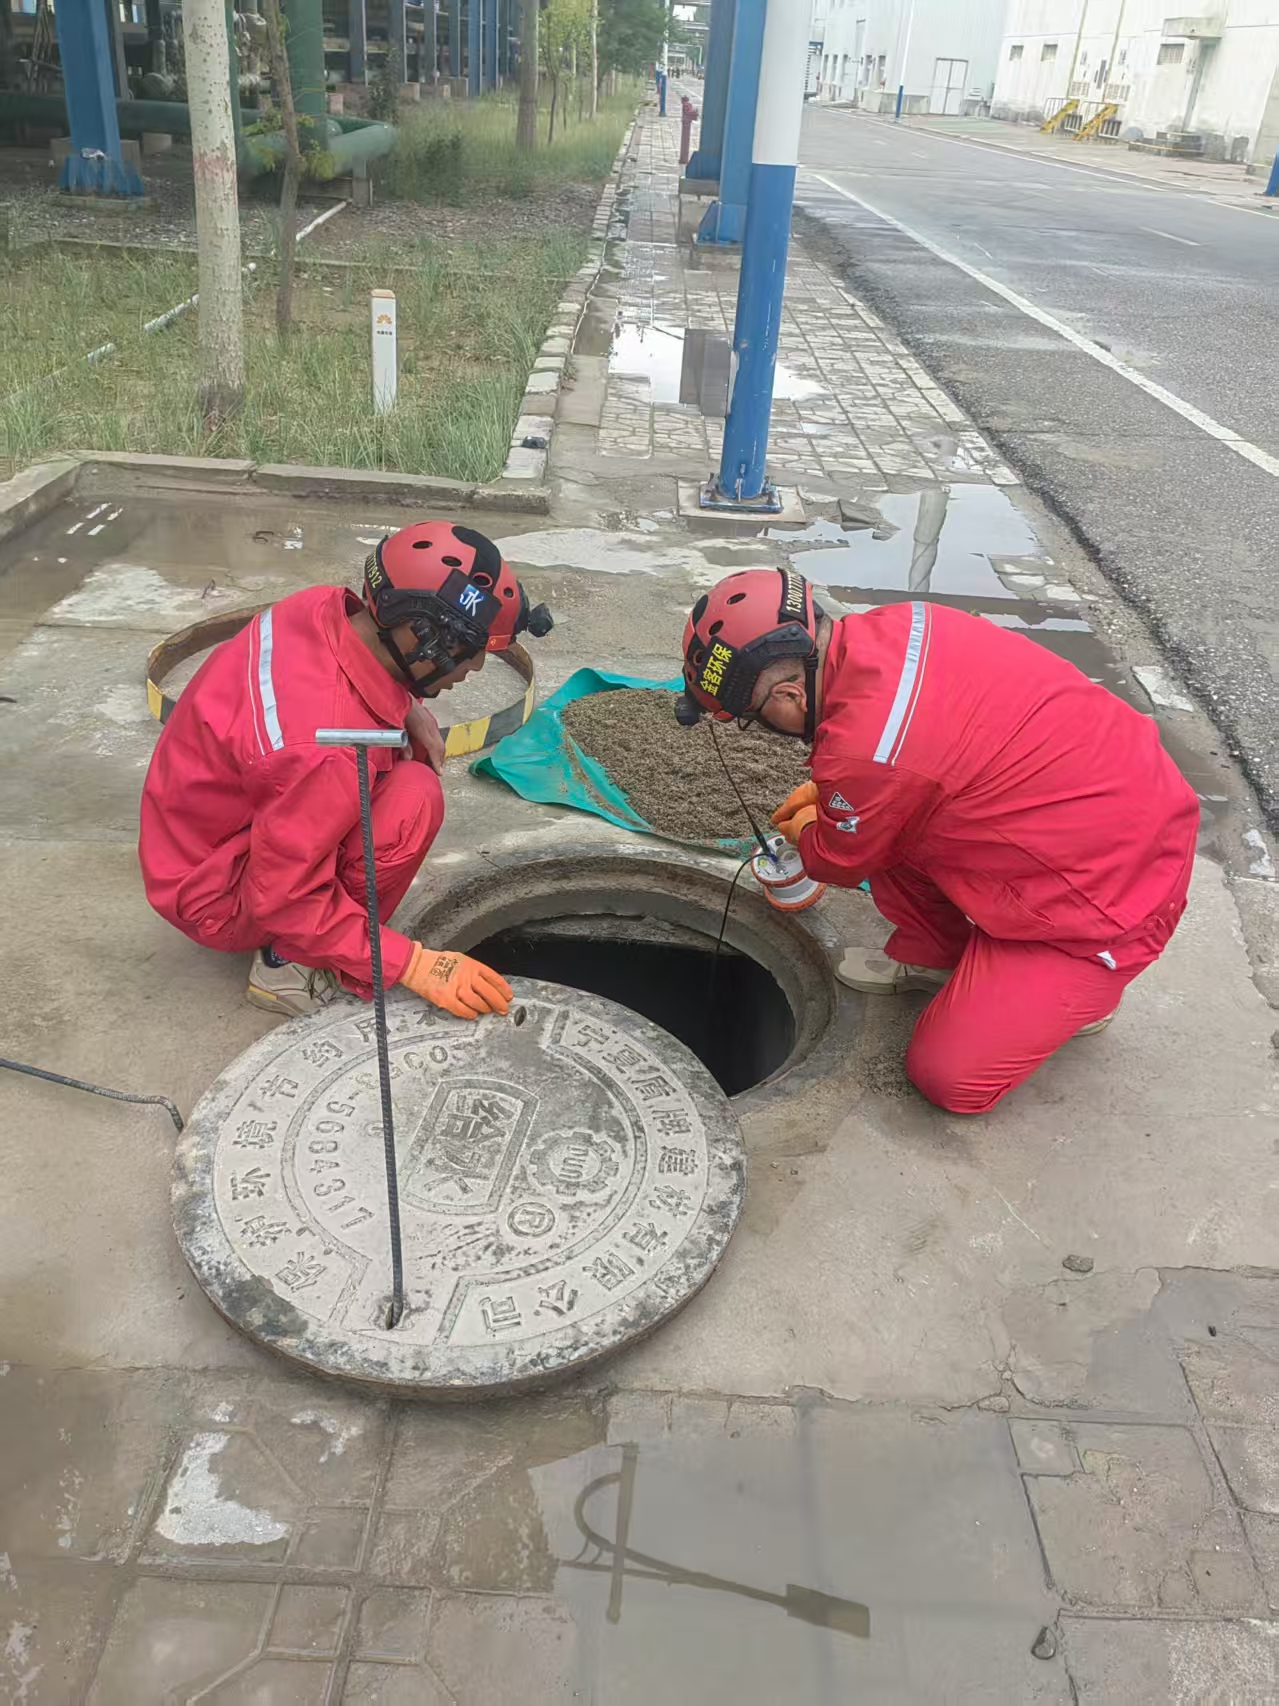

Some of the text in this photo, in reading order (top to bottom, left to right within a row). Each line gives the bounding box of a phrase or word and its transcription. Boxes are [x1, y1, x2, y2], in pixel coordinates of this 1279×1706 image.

[460, 588, 484, 617] JK
[699, 643, 733, 697] 金客环保
[424, 1093, 514, 1197] 给水
[481, 1022, 702, 1336] 宁夏盾牌建材有限公司
